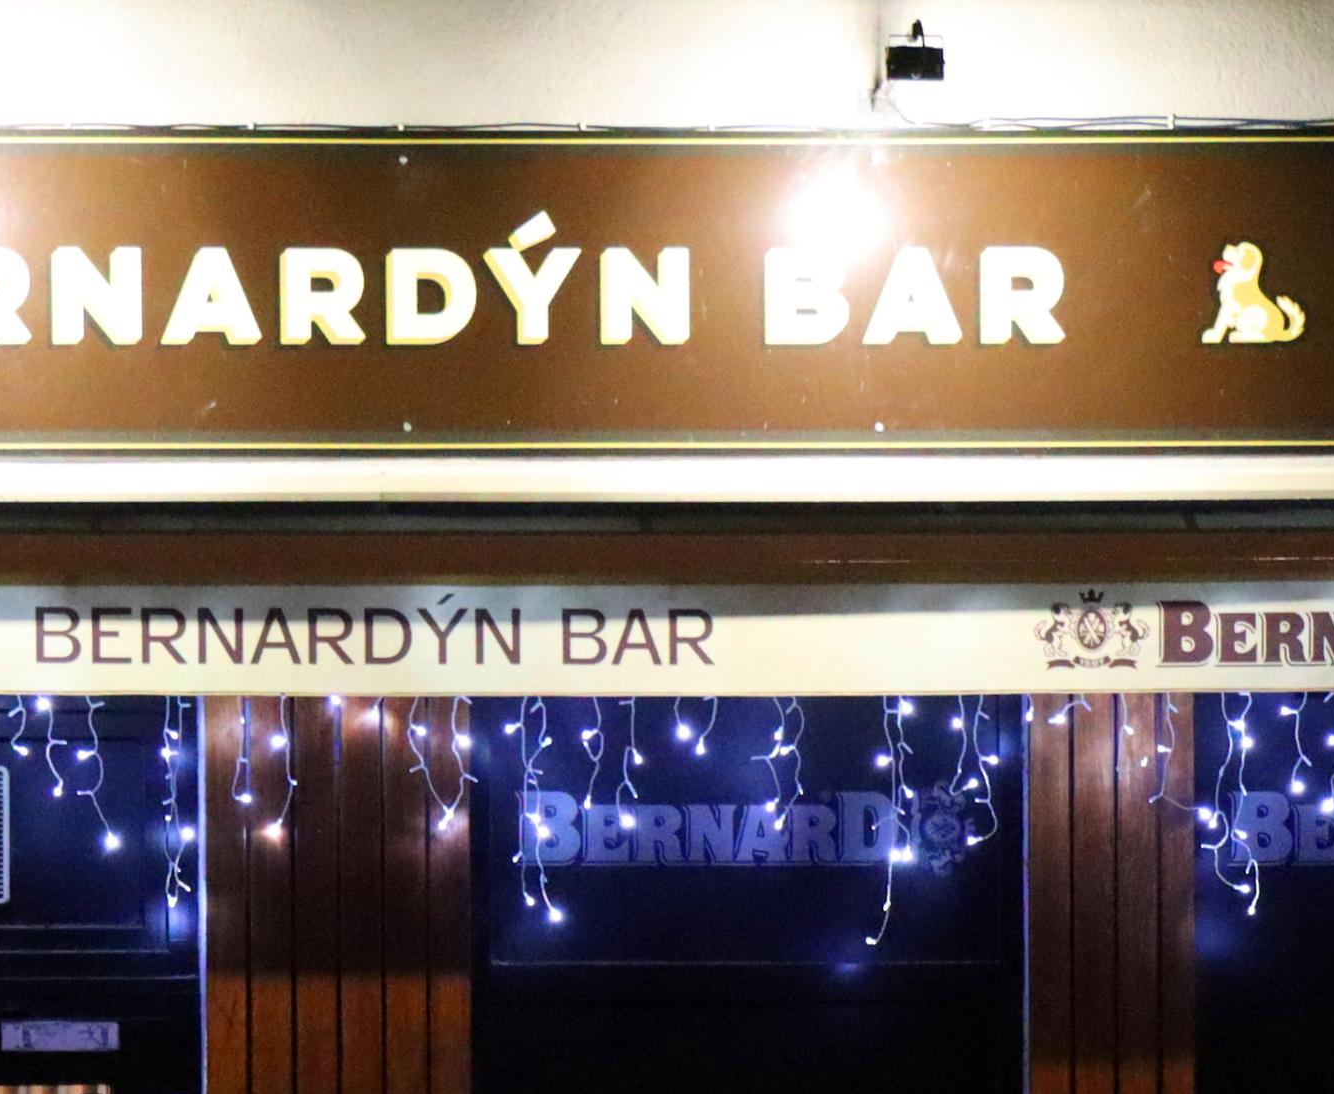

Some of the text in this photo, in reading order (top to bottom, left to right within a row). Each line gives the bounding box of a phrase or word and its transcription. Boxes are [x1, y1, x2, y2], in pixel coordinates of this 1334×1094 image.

[762, 242, 1068, 349] BAR
[35, 592, 716, 666] BERNARDÝN BAR
[517, 788, 919, 867] BERNARD
